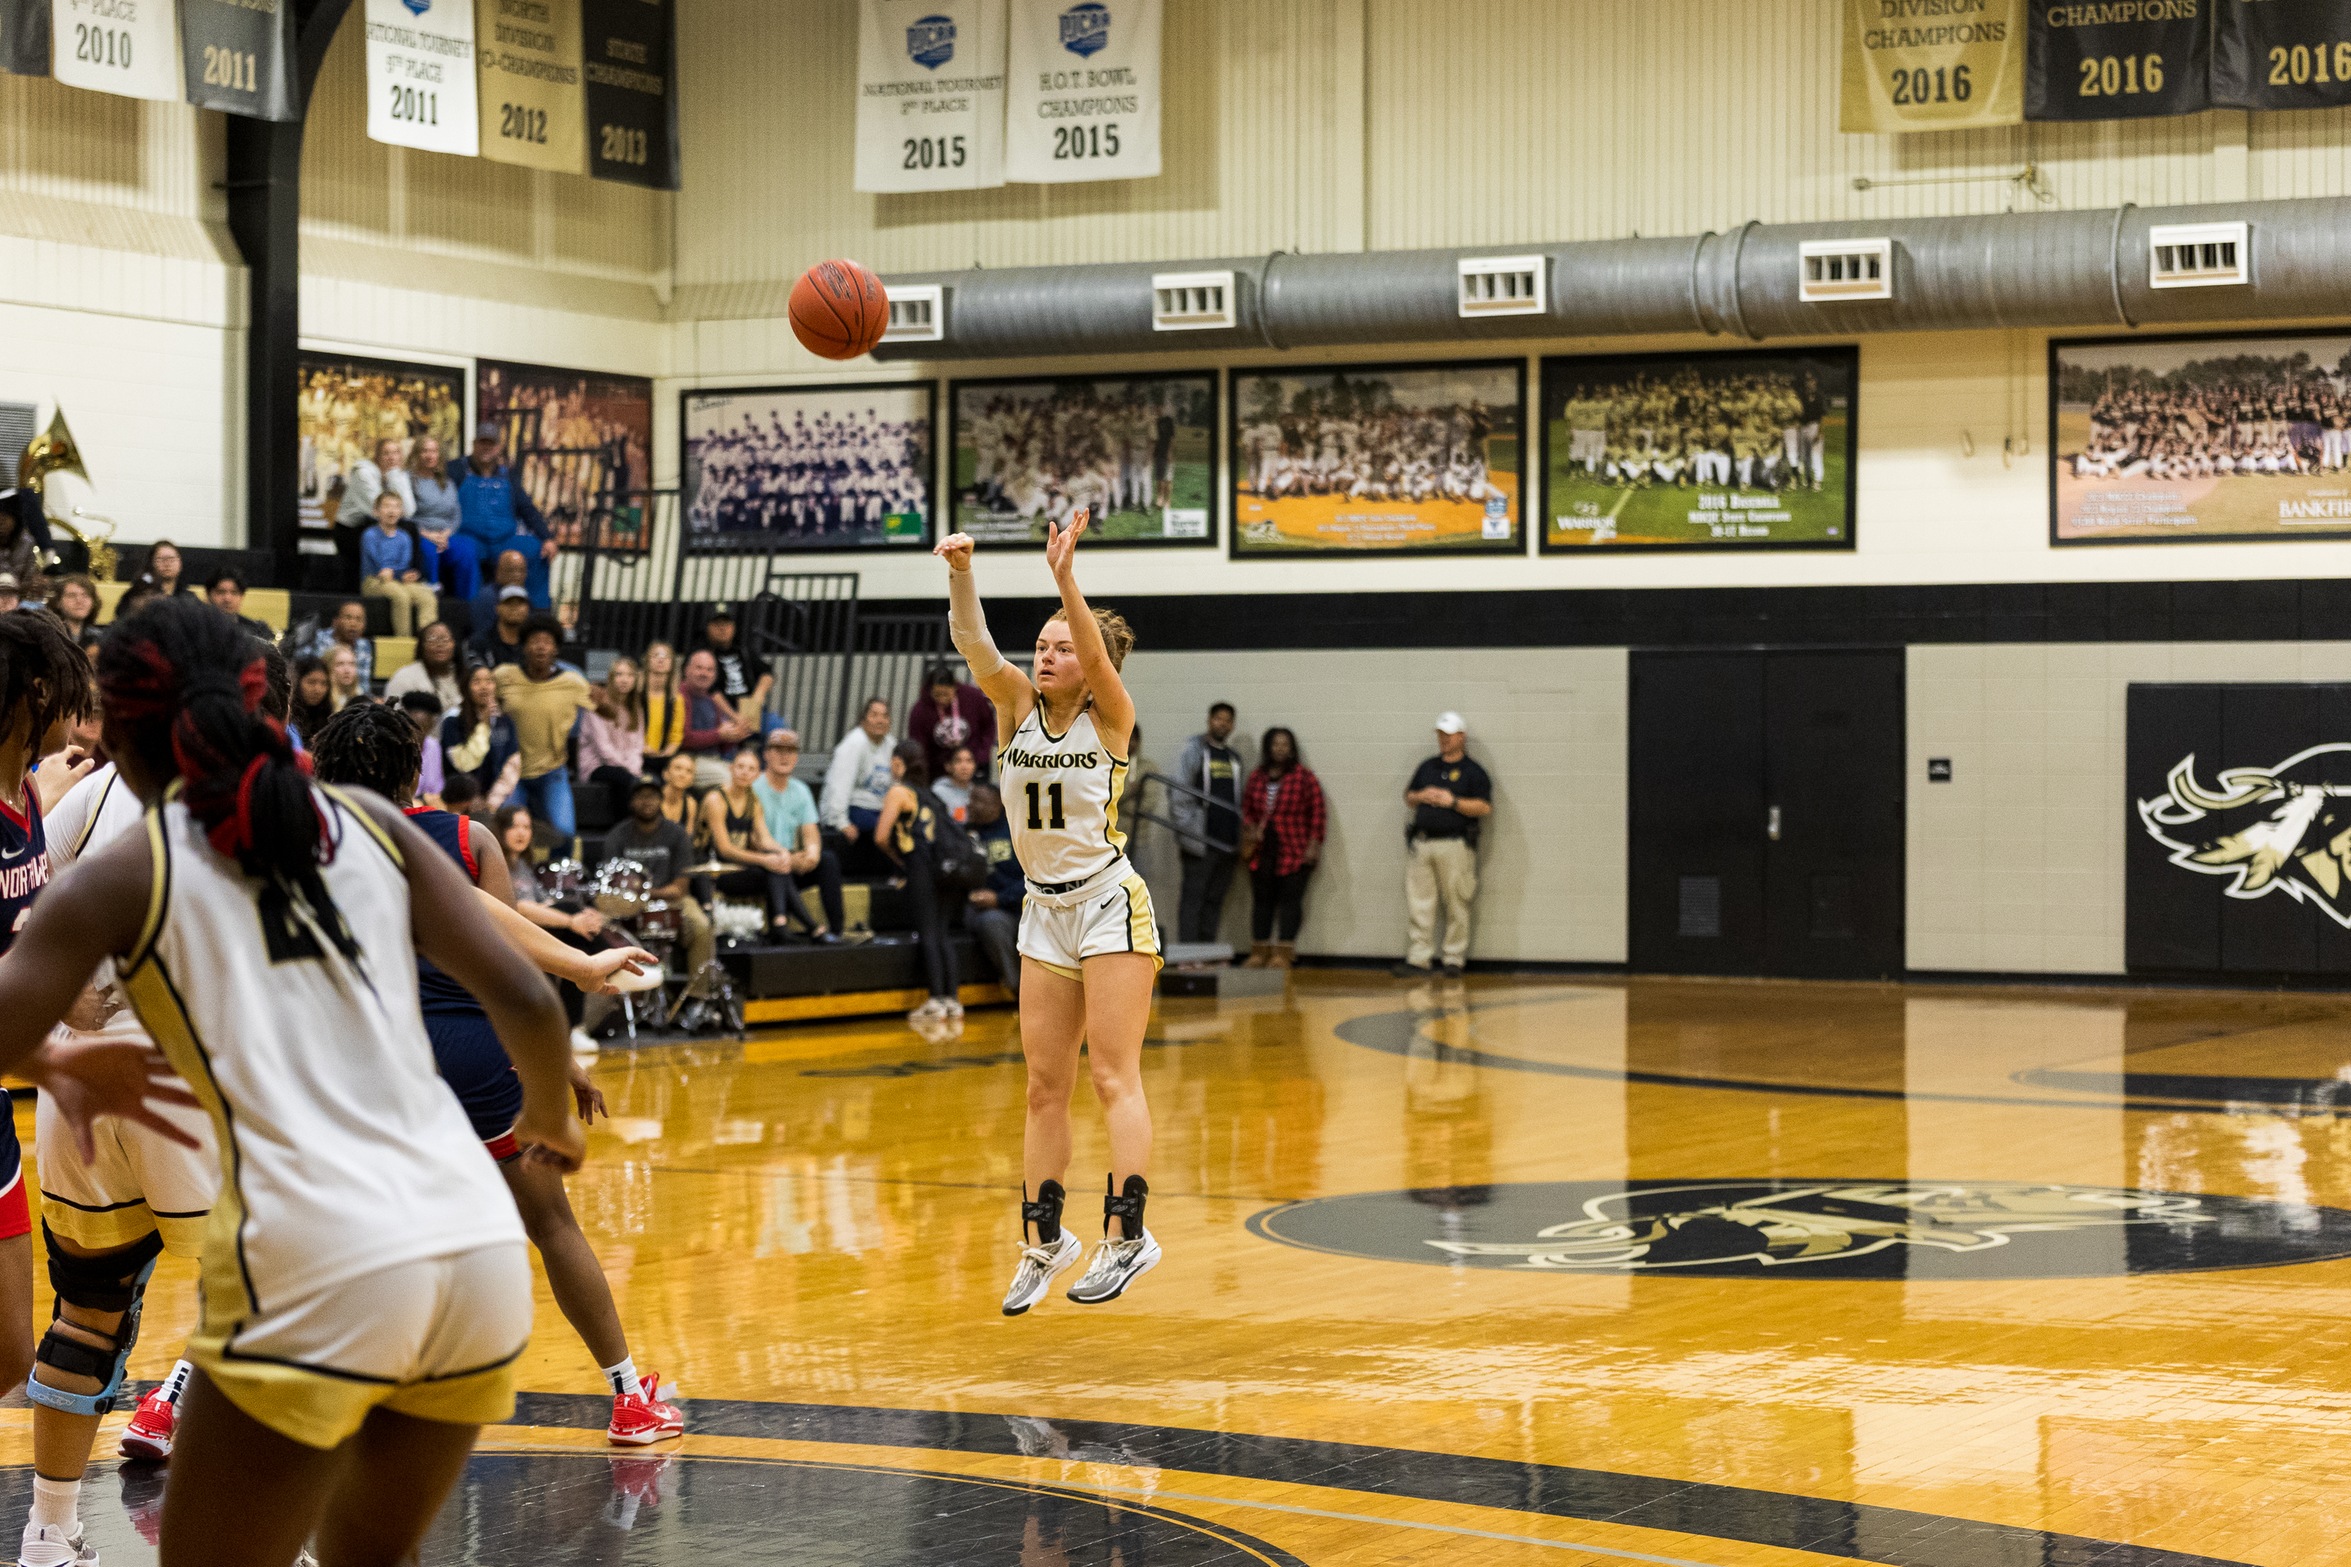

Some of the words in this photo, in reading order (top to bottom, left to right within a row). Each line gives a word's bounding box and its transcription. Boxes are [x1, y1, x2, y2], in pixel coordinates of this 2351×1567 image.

[1879, 0, 1985, 18] DIVISION
[2047, 0, 2198, 28] CHAMPIONS
[75, 22, 131, 69] 2010
[1863, 20, 2007, 50] CHAMPIONS
[203, 44, 257, 92] 2011
[1086, 67, 1137, 88] BOWL
[2078, 52, 2165, 97] 2016
[2267, 40, 2351, 86] 2016
[390, 84, 438, 126] 2011
[1891, 64, 1972, 106] 2016
[501, 101, 548, 144] 2012
[1037, 96, 1139, 119] CHAMPIONS
[600, 123, 648, 164] 2013
[903, 136, 967, 171] 2015
[1054, 124, 1121, 160] 2015
[1008, 748, 1098, 770] WARRIORS
[1024, 781, 1066, 830] 11
